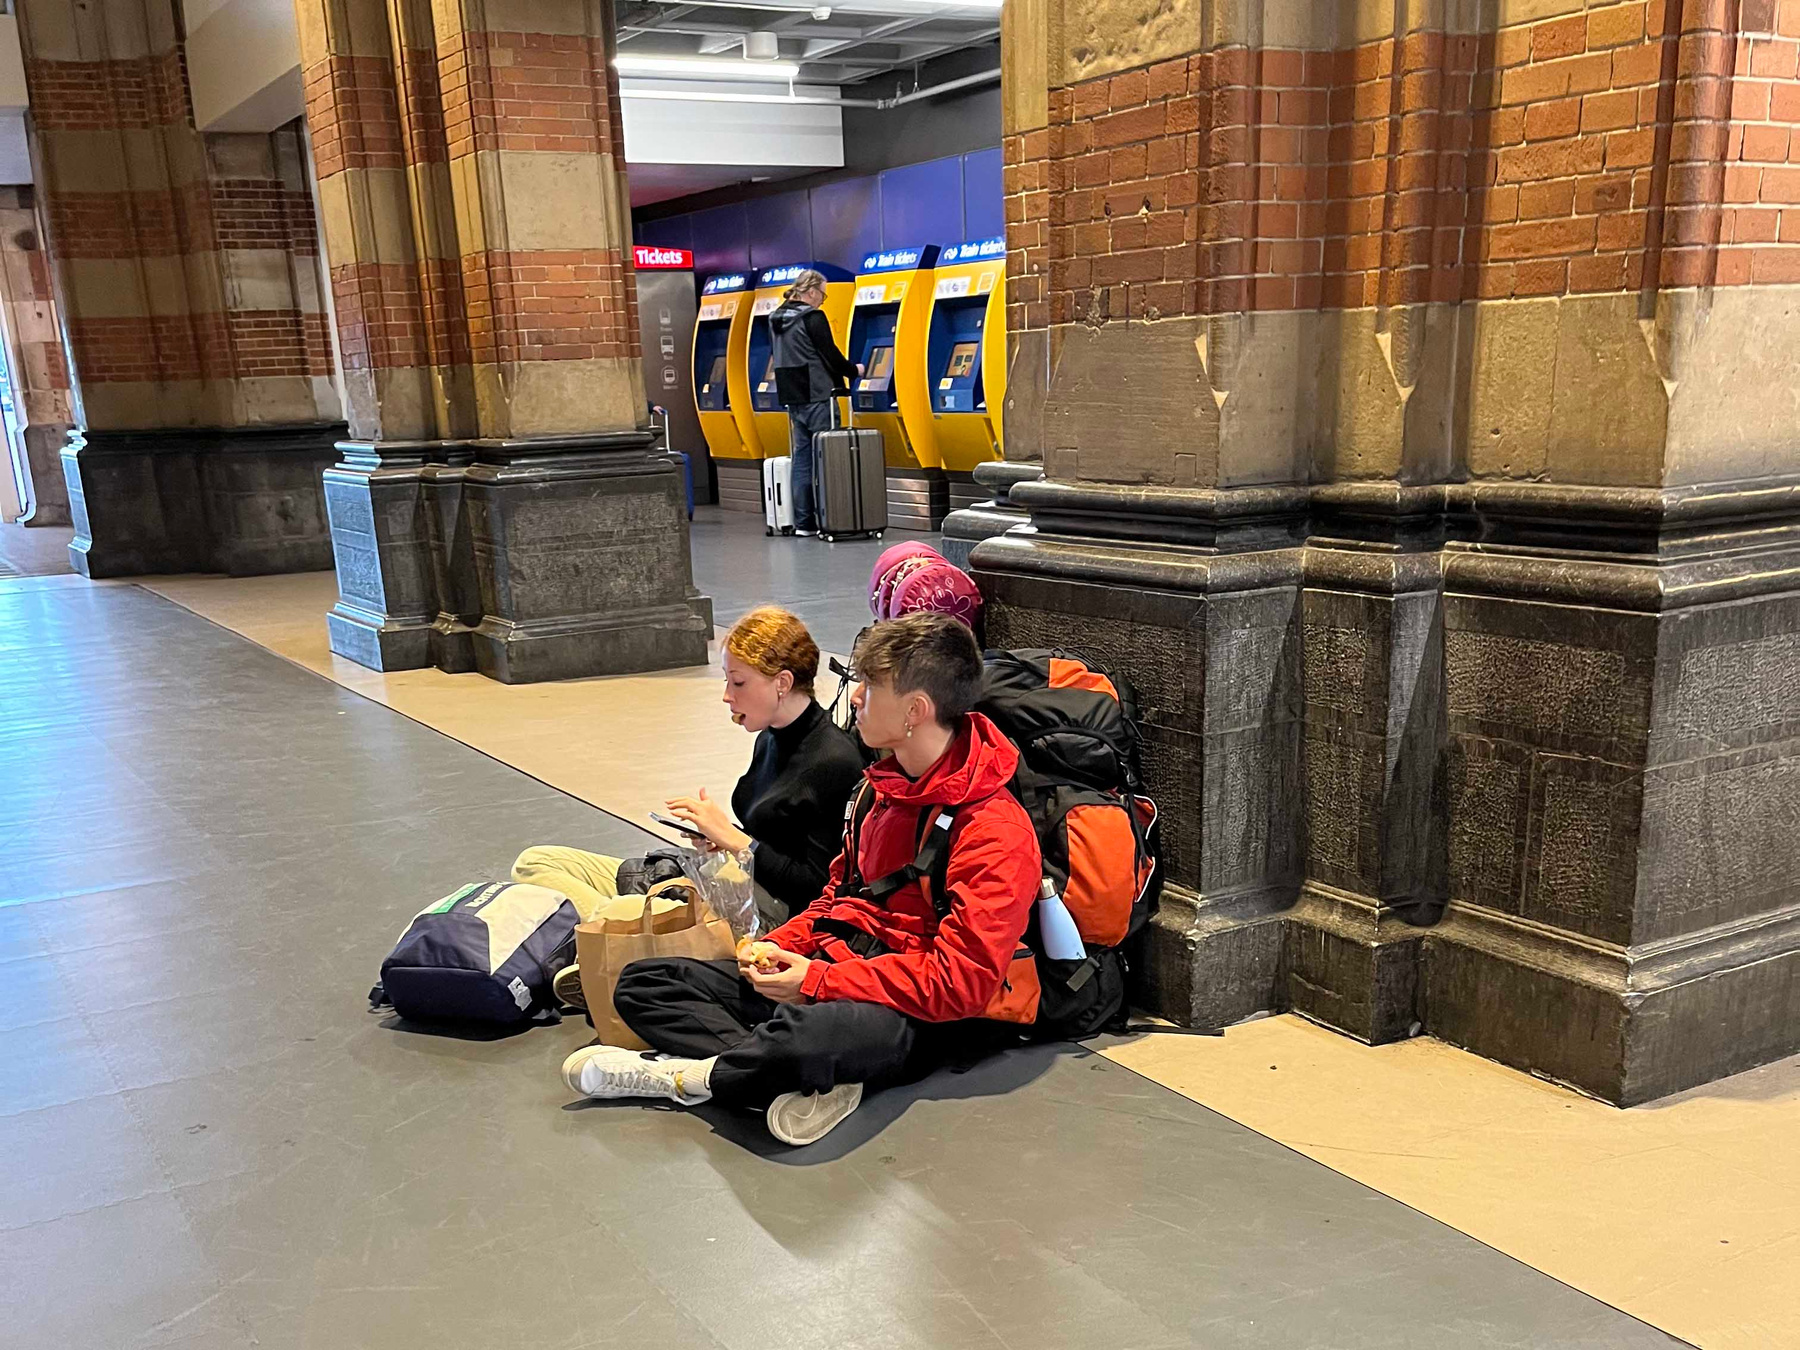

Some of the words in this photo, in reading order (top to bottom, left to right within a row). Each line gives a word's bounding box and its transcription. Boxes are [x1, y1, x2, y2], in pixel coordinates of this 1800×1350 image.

[636, 248, 683, 264] Tickets
[959, 243, 980, 258] Train
[979, 240, 1006, 254] tickets
[877, 254, 894, 267] Train
[894, 251, 918, 265] tickets
[716, 277, 730, 289] Train
[772, 269, 788, 281] Train
